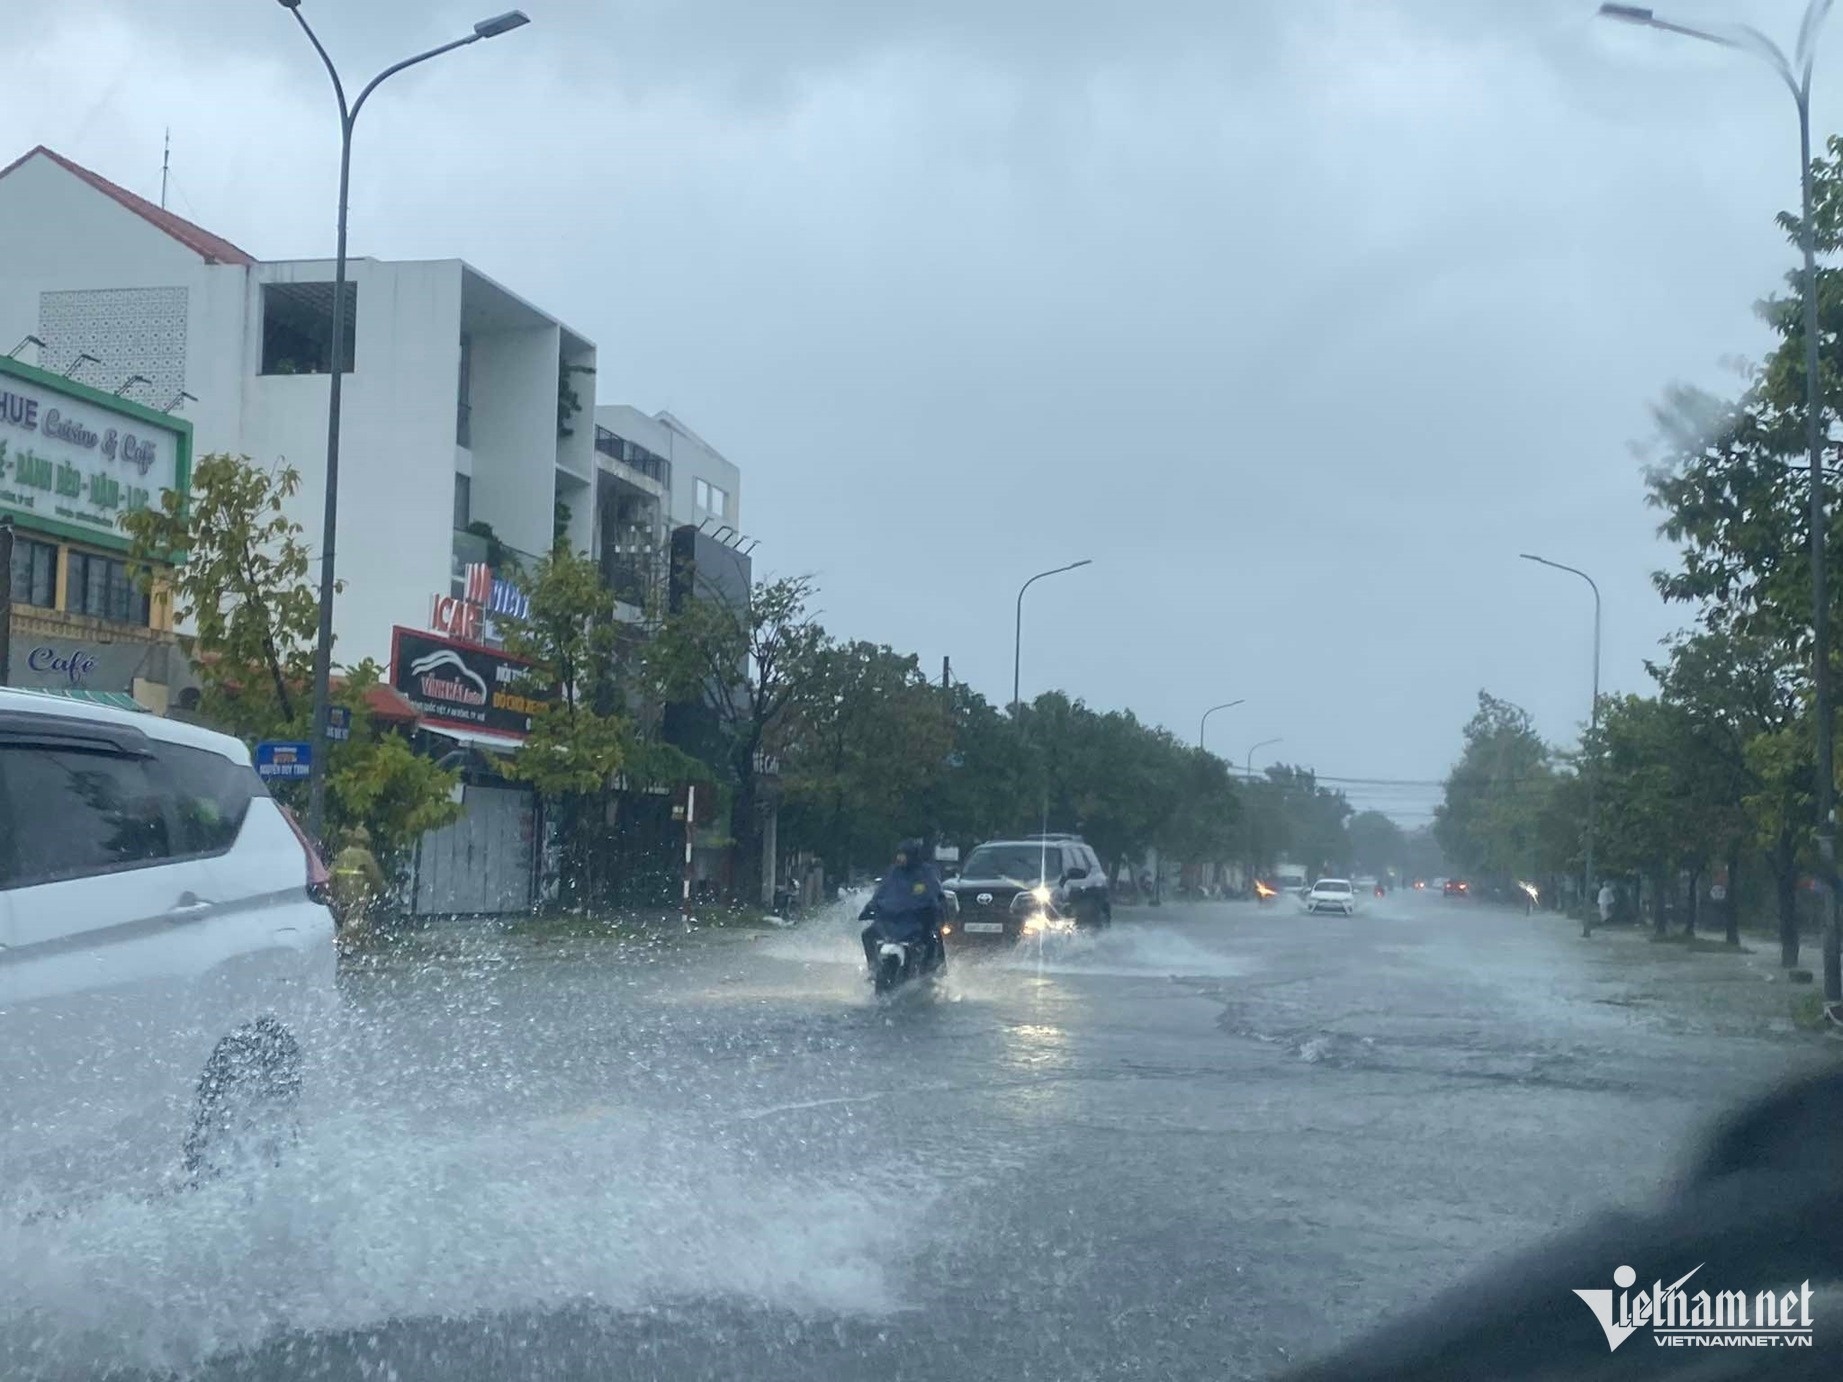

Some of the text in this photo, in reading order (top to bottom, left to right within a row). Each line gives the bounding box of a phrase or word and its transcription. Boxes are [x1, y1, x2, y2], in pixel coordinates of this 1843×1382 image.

[41, 408, 99, 448] Cuisine
[101, 428, 118, 460] &
[27, 647, 96, 684] Café
